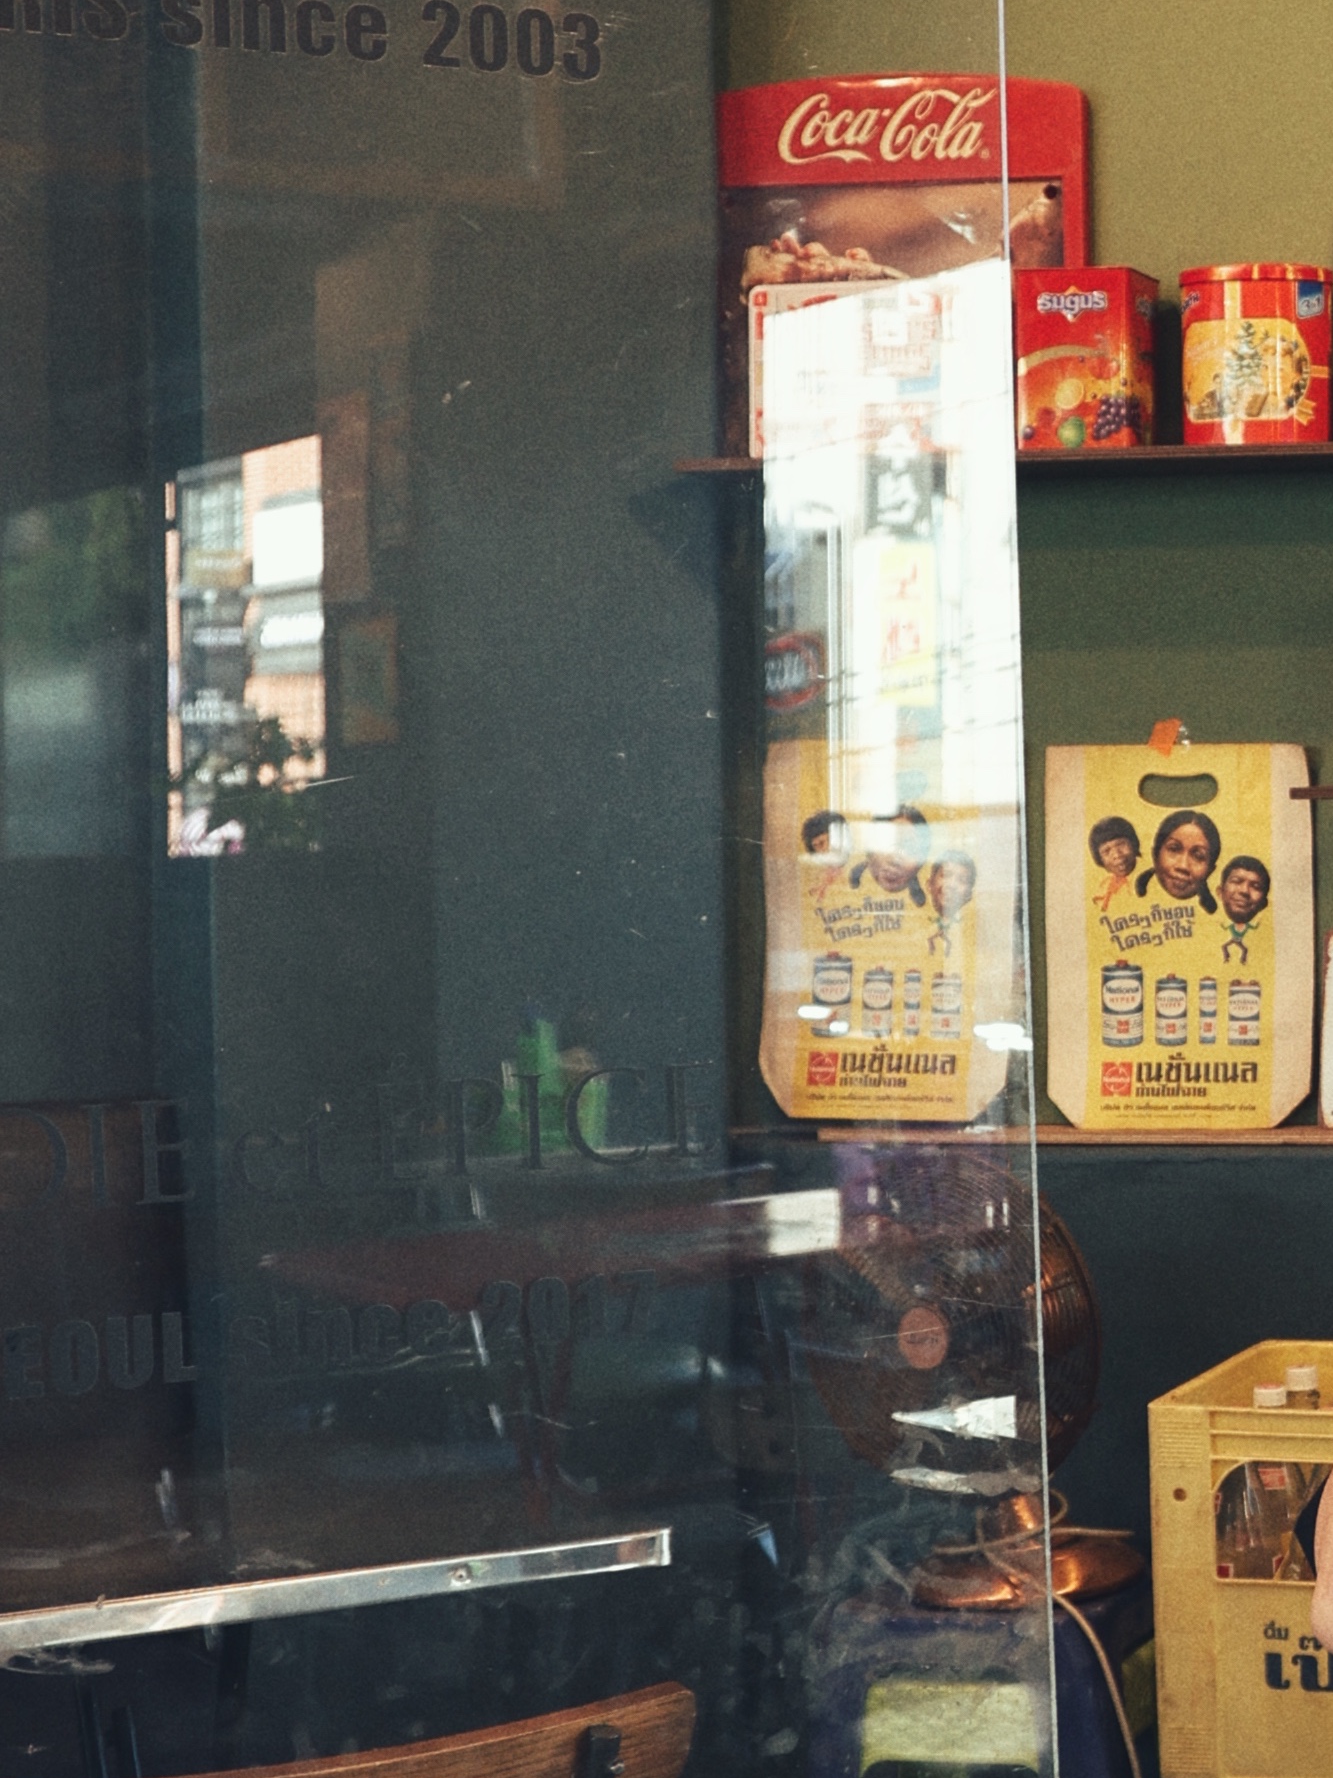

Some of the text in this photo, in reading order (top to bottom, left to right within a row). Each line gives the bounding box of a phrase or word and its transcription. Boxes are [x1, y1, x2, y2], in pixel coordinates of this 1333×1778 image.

[777, 87, 998, 165] Coca-Cola
[1038, 291, 1107, 314] sugus
[1135, 1051, 1259, 1084] เนชั่นแนล
